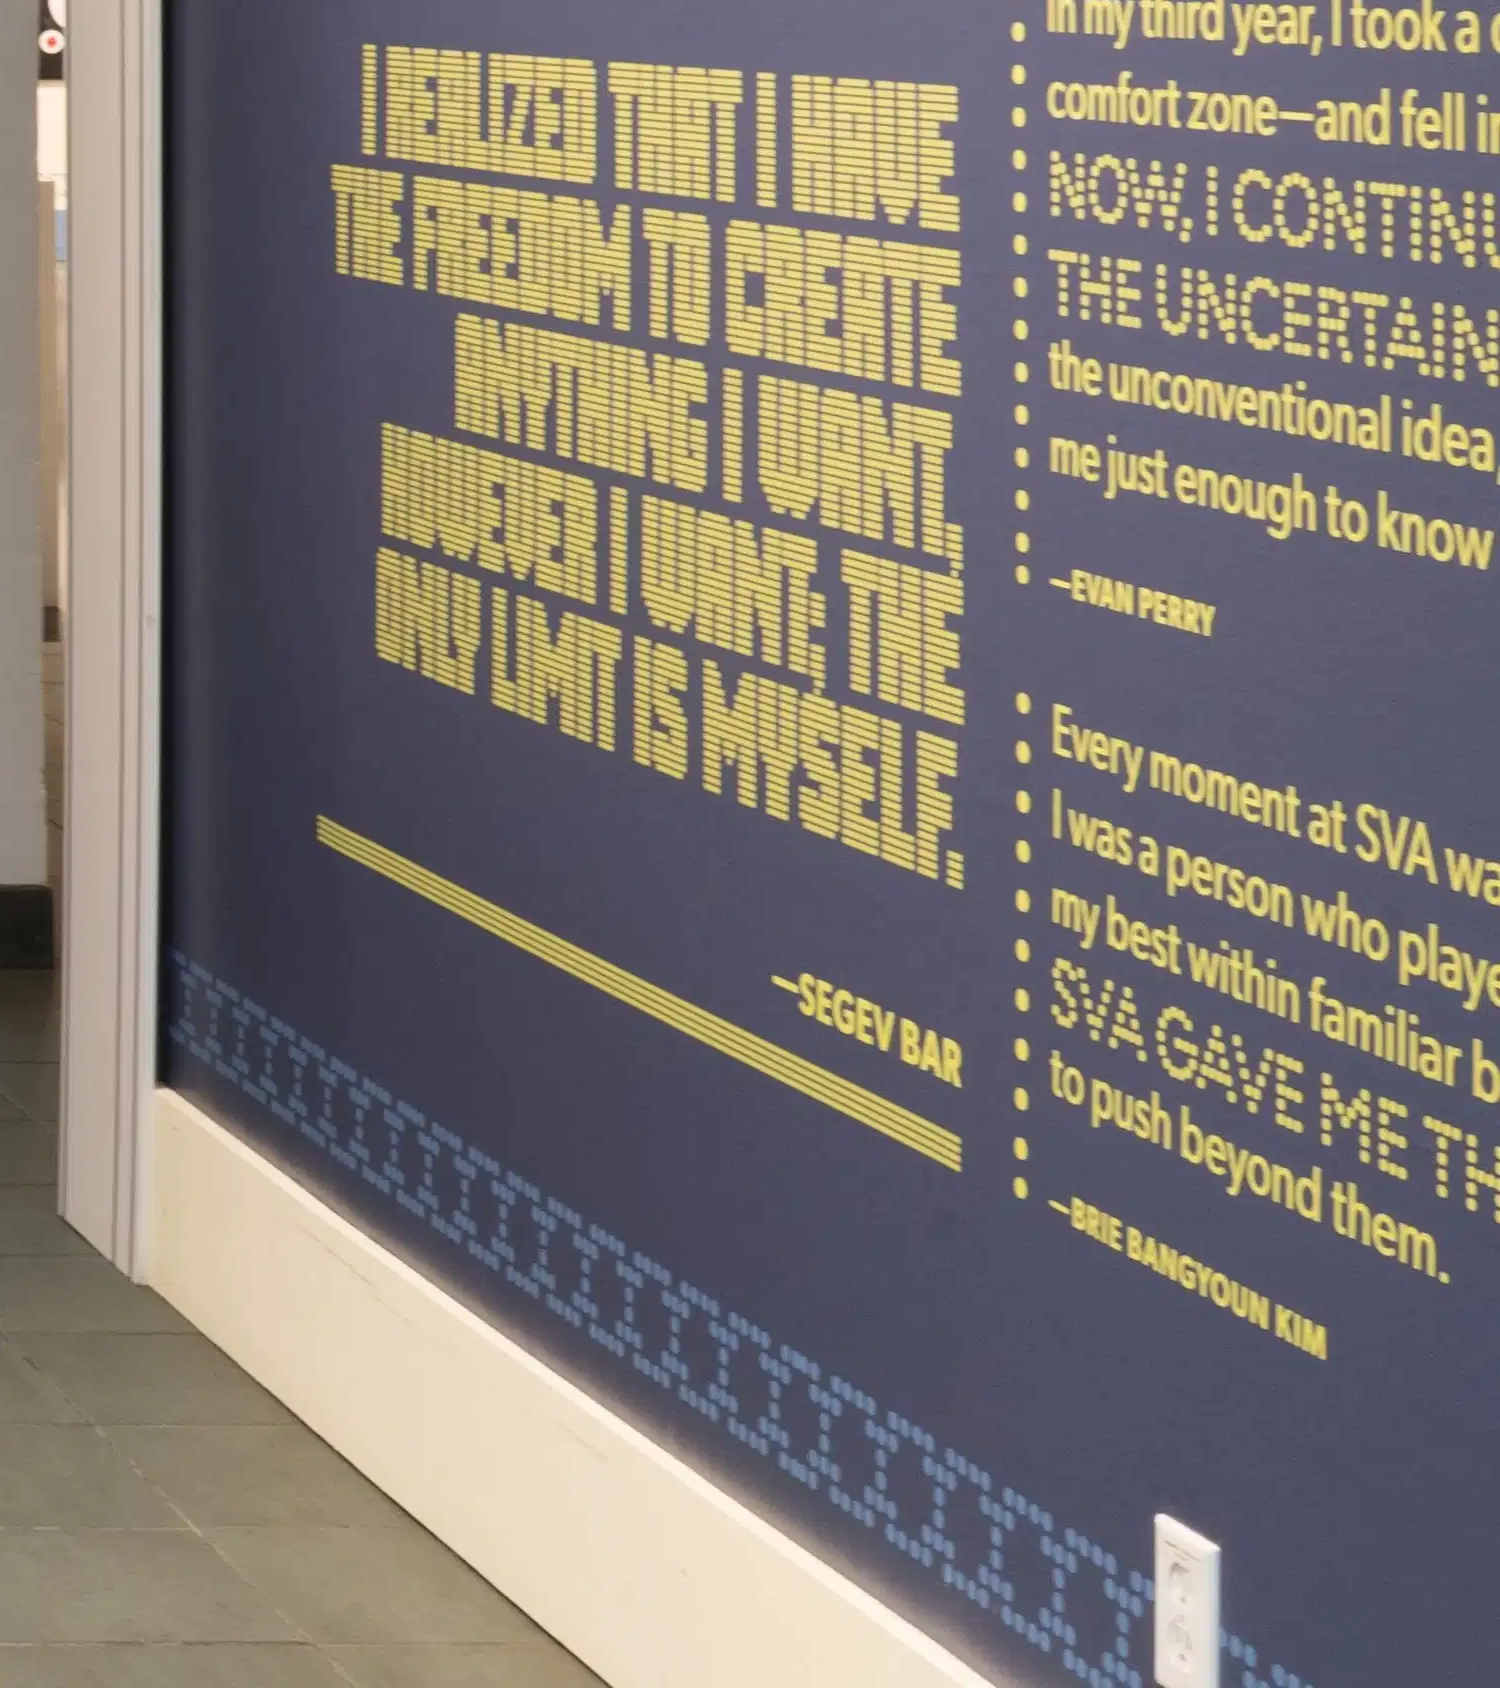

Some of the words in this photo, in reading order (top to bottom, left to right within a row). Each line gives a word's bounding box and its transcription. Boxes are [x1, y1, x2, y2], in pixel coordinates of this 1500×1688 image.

[1047, 71, 1181, 129] comfort
[1400, 88, 1465, 151] fell
[1083, 0, 1135, 50] my
[1231, 3, 1323, 56] year,
[1454, 10, 1480, 54] a
[361, 43, 377, 156] I
[385, 44, 597, 184] REALIZED
[607, 61, 743, 203] THAT
[756, 72, 777, 208] I
[791, 74, 961, 232] HAVE
[1050, 150, 1193, 244] NOW,
[1206, 165, 1218, 236] I
[330, 163, 404, 286] THE
[412, 174, 631, 331] FREEDOM
[642, 207, 710, 346] TO
[725, 218, 962, 396] CREATE
[1047, 248, 1141, 329] THE
[1155, 263, 1500, 388] UNCERTAIN
[454, 312, 708, 494] ANYTHING
[722, 367, 743, 503] I
[757, 373, 964, 577] WANT,
[1047, 339, 1102, 395] the
[1108, 362, 1392, 453] unconventional
[381, 421, 598, 605] HOWEVER
[609, 485, 628, 615] I
[841, 548, 965, 725] THE
[1050, 436, 1100, 483] me
[1103, 434, 1169, 500] just
[1174, 464, 1317, 540] enough
[1324, 485, 1369, 543] to
[1377, 490, 1494, 570] know
[1139, 586, 1216, 637] PERRY
[375, 547, 481, 695] ONLY
[491, 587, 622, 752] LIMIT
[633, 635, 688, 780] IS
[702, 658, 964, 890] MYSELF.
[1052, 703, 1143, 793] Every
[1149, 750, 1301, 838] moment
[1307, 800, 1347, 853] at
[1354, 803, 1438, 884] SVA
[1052, 788, 1063, 839] I
[1067, 807, 1133, 866] was
[1138, 835, 1159, 877] a
[1167, 845, 1293, 928] person
[1300, 891, 1390, 962] who
[900, 1017, 963, 1088] BAR
[1051, 957, 1147, 1062] SVA
[1156, 1005, 1304, 1134] GAVE
[1320, 1072, 1408, 1180] ME
[1052, 888, 1100, 950] my
[1106, 894, 1183, 975] best
[1187, 940, 1300, 1023] within
[1308, 976, 1463, 1087] familiar
[1049, 1050, 1084, 1105] to
[1091, 1078, 1171, 1150] push
[1180, 1105, 1322, 1223] beyond
[1330, 1181, 1450, 1284] them.
[1127, 1226, 1269, 1331] BANGYOUN
[1275, 1303, 1327, 1361] KIM
